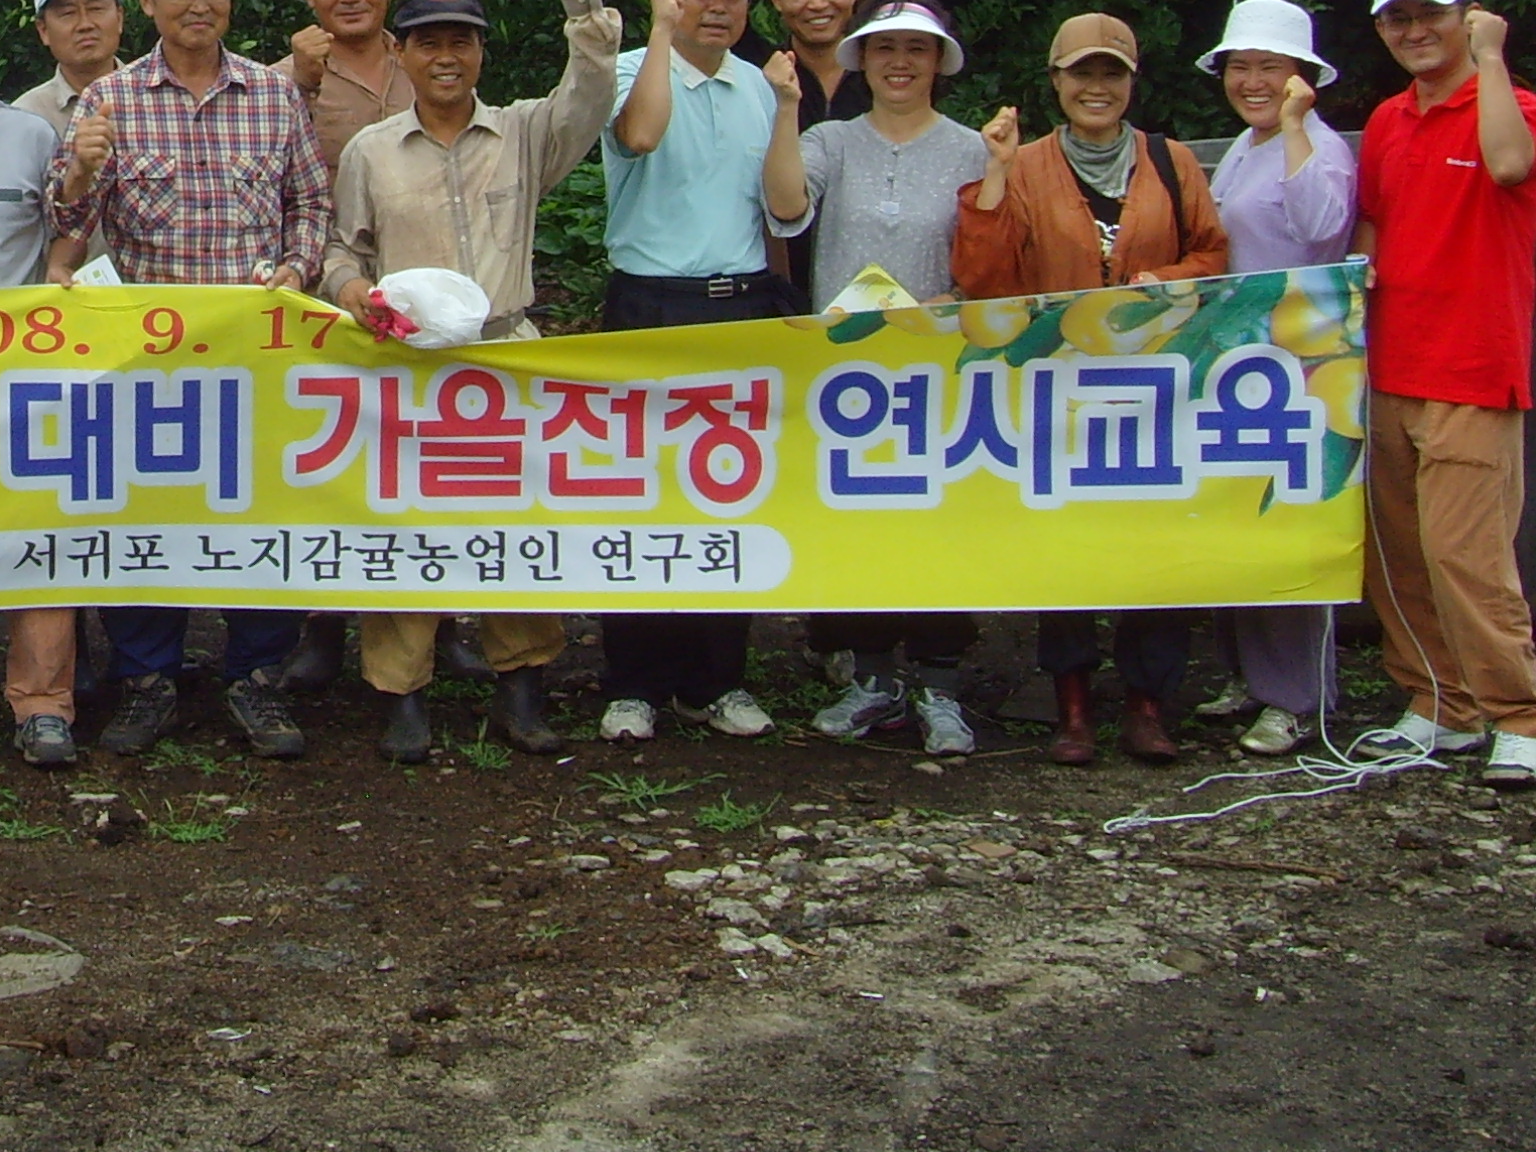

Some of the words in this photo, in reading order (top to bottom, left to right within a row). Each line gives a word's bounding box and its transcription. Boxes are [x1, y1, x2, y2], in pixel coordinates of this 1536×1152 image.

[143, 308, 210, 355] 9.
[260, 306, 340, 351] 17
[8, 378, 240, 504] 대비
[295, 368, 770, 505] 가을전정
[817, 355, 1312, 497] 연시교육
[12, 529, 171, 581] 서귀포
[192, 528, 564, 583] 노지감귤농업인
[591, 529, 744, 584] 연구회
